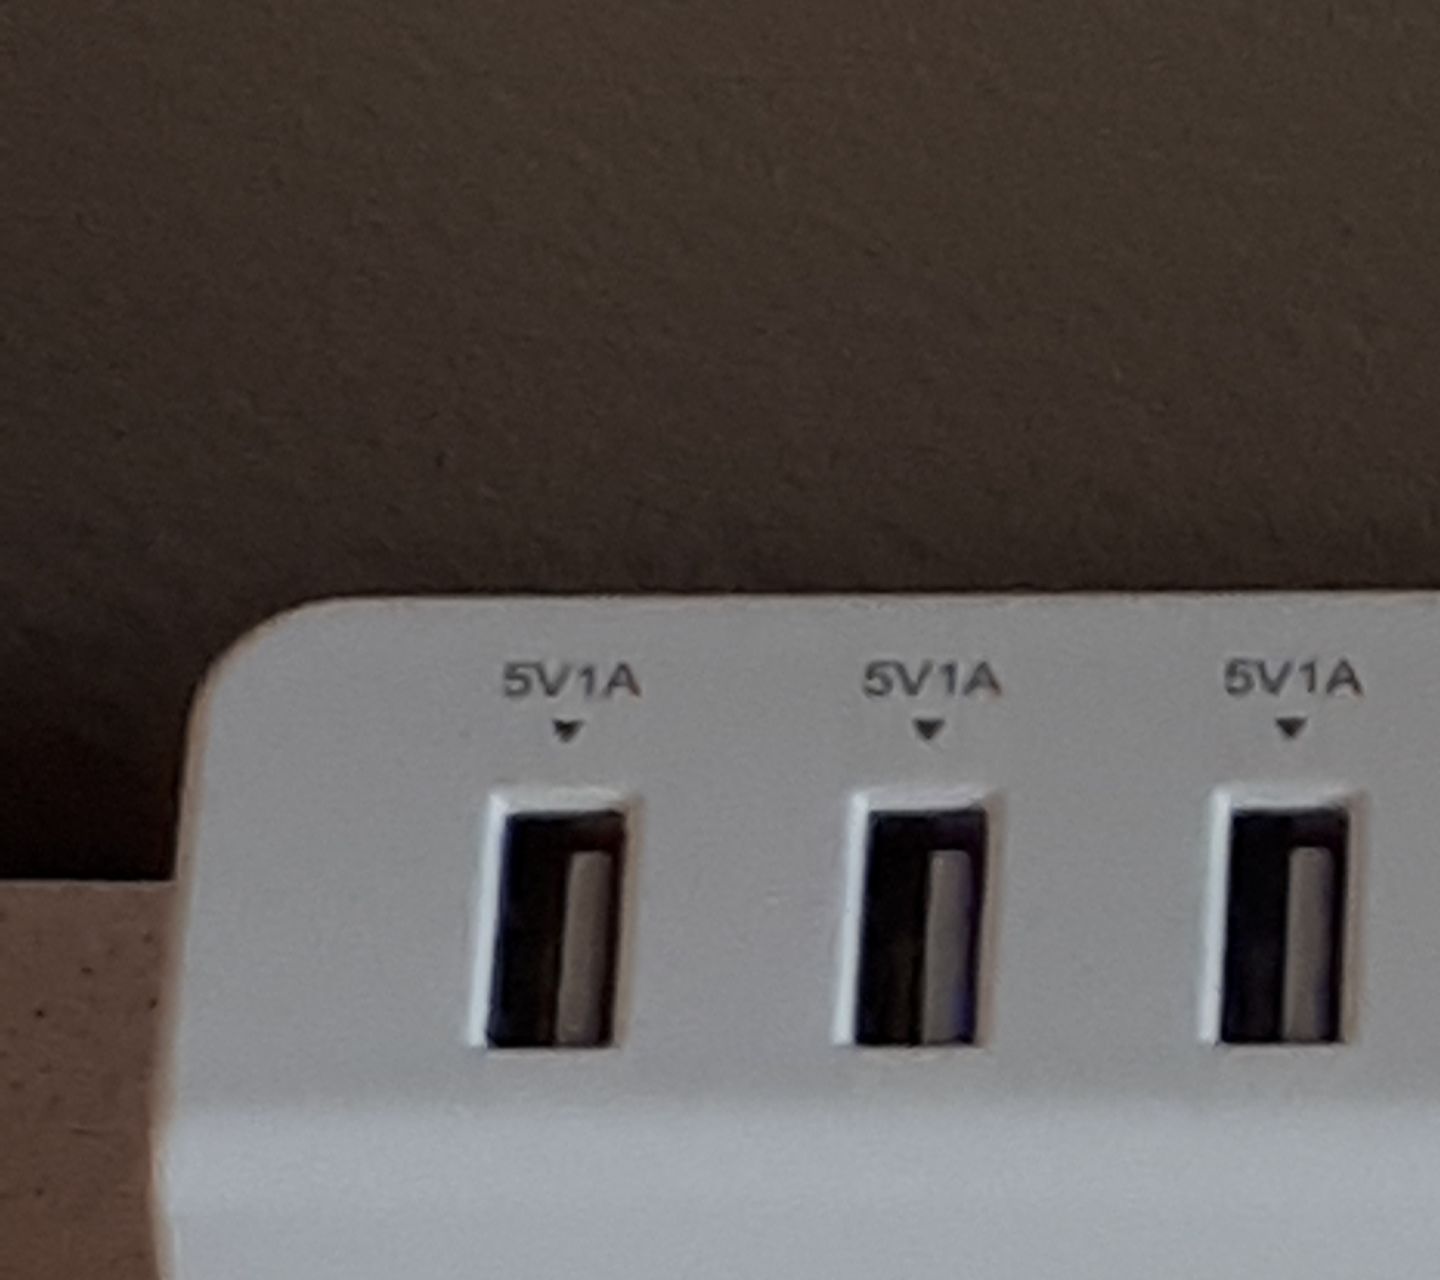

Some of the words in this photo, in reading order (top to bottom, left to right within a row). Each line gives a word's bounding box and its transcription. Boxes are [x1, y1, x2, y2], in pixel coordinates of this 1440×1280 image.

[503, 661, 641, 699] 5V1A
[862, 660, 1002, 698] 5V1A
[1224, 658, 1363, 697] 5V1A
